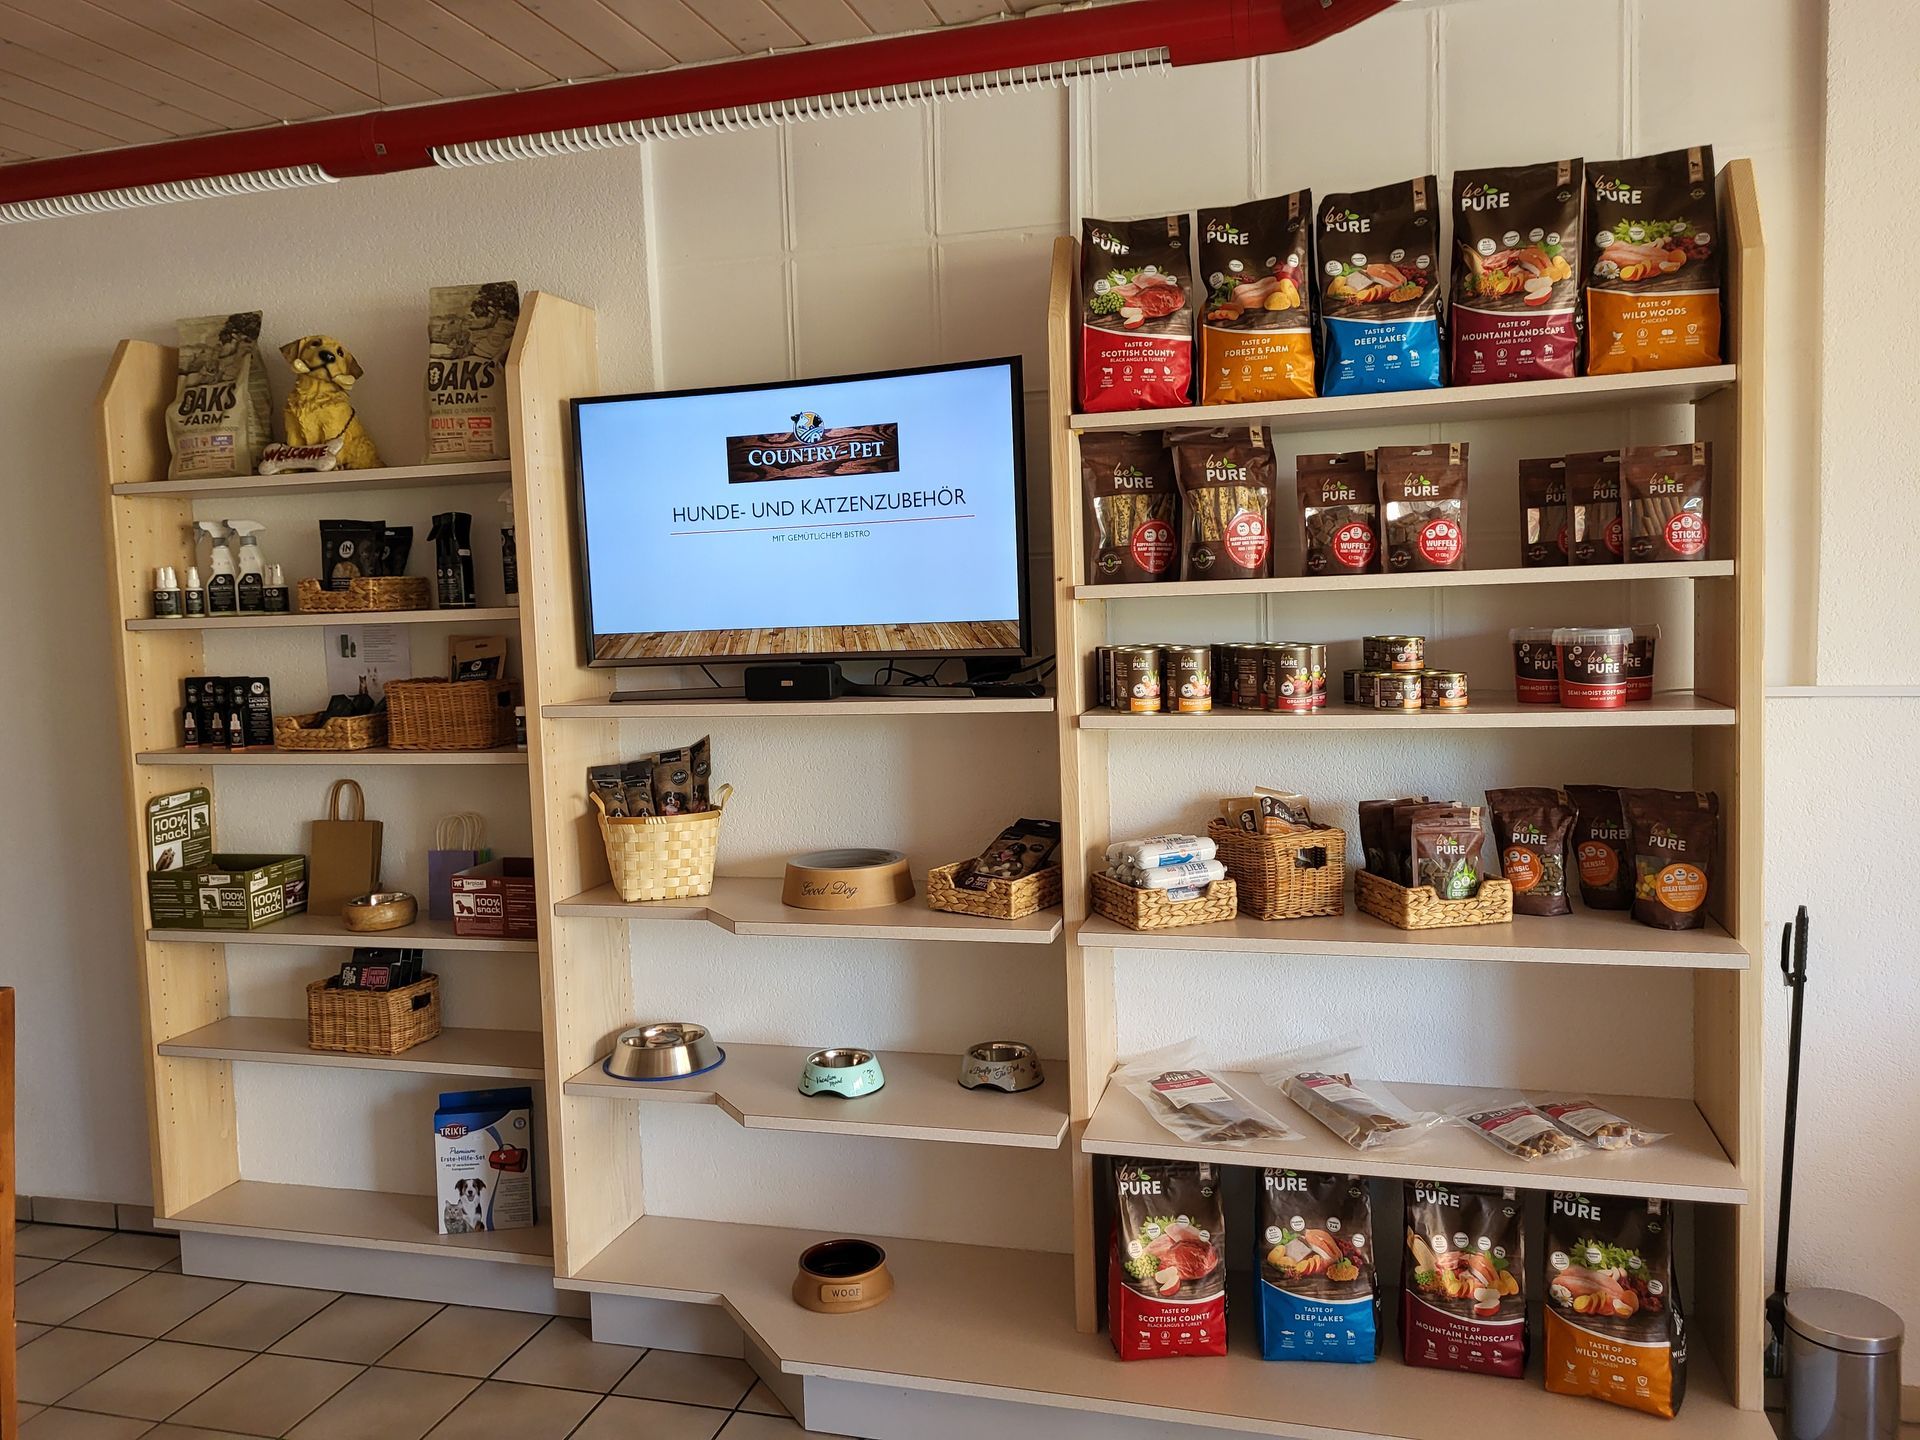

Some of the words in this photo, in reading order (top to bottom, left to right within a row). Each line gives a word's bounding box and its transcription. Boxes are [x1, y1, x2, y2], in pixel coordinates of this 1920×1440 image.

[1595, 174, 1616, 190] be
[1462, 182, 1481, 197] be
[1596, 189, 1642, 204] PURE
[1462, 192, 1510, 212] PURE
[1325, 207, 1345, 225] be
[1207, 219, 1226, 232] be
[1326, 219, 1370, 233] PURE
[1092, 236, 1130, 254] PURE
[1206, 231, 1249, 246] PURE
[1622, 310, 1646, 320] WILD
[1650, 308, 1687, 318] WOODS
[1354, 337, 1377, 346] DEEP
[1380, 334, 1406, 343] LAKES
[1462, 330, 1511, 341] MOUNTAIN
[1514, 326, 1566, 338] LANDSCAPE
[1224, 348, 1255, 357] FOREST
[428, 361, 496, 392] OAKS
[178, 384, 237, 416] OAKS
[438, 392, 480, 406] FARM
[263, 446, 328, 461] WELCOME
[748, 441, 884, 468] COUNTRY-PET
[1206, 454, 1225, 469] be
[1114, 462, 1132, 477] be
[1206, 467, 1247, 482] PURE
[1114, 477, 1154, 489] PURE
[1322, 479, 1337, 491] be
[1404, 472, 1419, 486] be
[1650, 472, 1665, 485] be
[1404, 485, 1439, 497] PURE
[1594, 489, 1620, 500] PUR
[1650, 483, 1684, 494] PURE
[1322, 490, 1356, 502] PURE
[673, 502, 746, 523] HUNDE-
[752, 500, 796, 519] UND
[800, 485, 966, 516] KATZENZUBEHÖR
[772, 534, 786, 542] MIT
[787, 530, 842, 542] GEMÜTLICHEM
[844, 530, 870, 539] BISTRO
[1535, 648, 1548, 660] be
[1588, 650, 1604, 664] be
[1534, 660, 1558, 670] PUR
[1588, 663, 1620, 673] PURE
[155, 814, 187, 832] 100%
[1513, 820, 1528, 832] be
[155, 827, 188, 843] snack
[1436, 834, 1448, 845] be
[1512, 833, 1547, 845] PURE
[1591, 829, 1627, 839] PURE
[1436, 845, 1466, 855] PURE
[1649, 836, 1686, 851] PURE
[1185, 863, 1207, 871] LIEBE
[222, 892, 244, 900] 100%
[801, 881, 830, 896] Good
[831, 881, 858, 899] Dog
[254, 890, 280, 908] 100%
[476, 898, 500, 906] 100%
[254, 902, 281, 917] snack
[368, 976, 387, 984] PANTS
[816, 1074, 836, 1084] Vacation
[440, 1126, 468, 1136] TRIXIE
[440, 1154, 486, 1162] Erste-Hilfe-Set
[1119, 1164, 1137, 1182] be
[1120, 1180, 1161, 1195] PURE
[1265, 1176, 1308, 1192] PURE
[1415, 1189, 1460, 1208] PURE
[1553, 1200, 1601, 1222] PURE
[832, 1289, 860, 1297] WOOF
[1179, 1312, 1210, 1322] COUNTY
[1416, 1321, 1462, 1338] MOUNTAIN
[1464, 1333, 1514, 1342] LANDSCAPE
[1449, 1322, 1469, 1331] TASTE
[1589, 1341, 1610, 1351] TASTE
[1575, 1347, 1598, 1358] WILD
[1600, 1353, 1638, 1366] WOODS
[1593, 1360, 1618, 1368] CHICKEN
